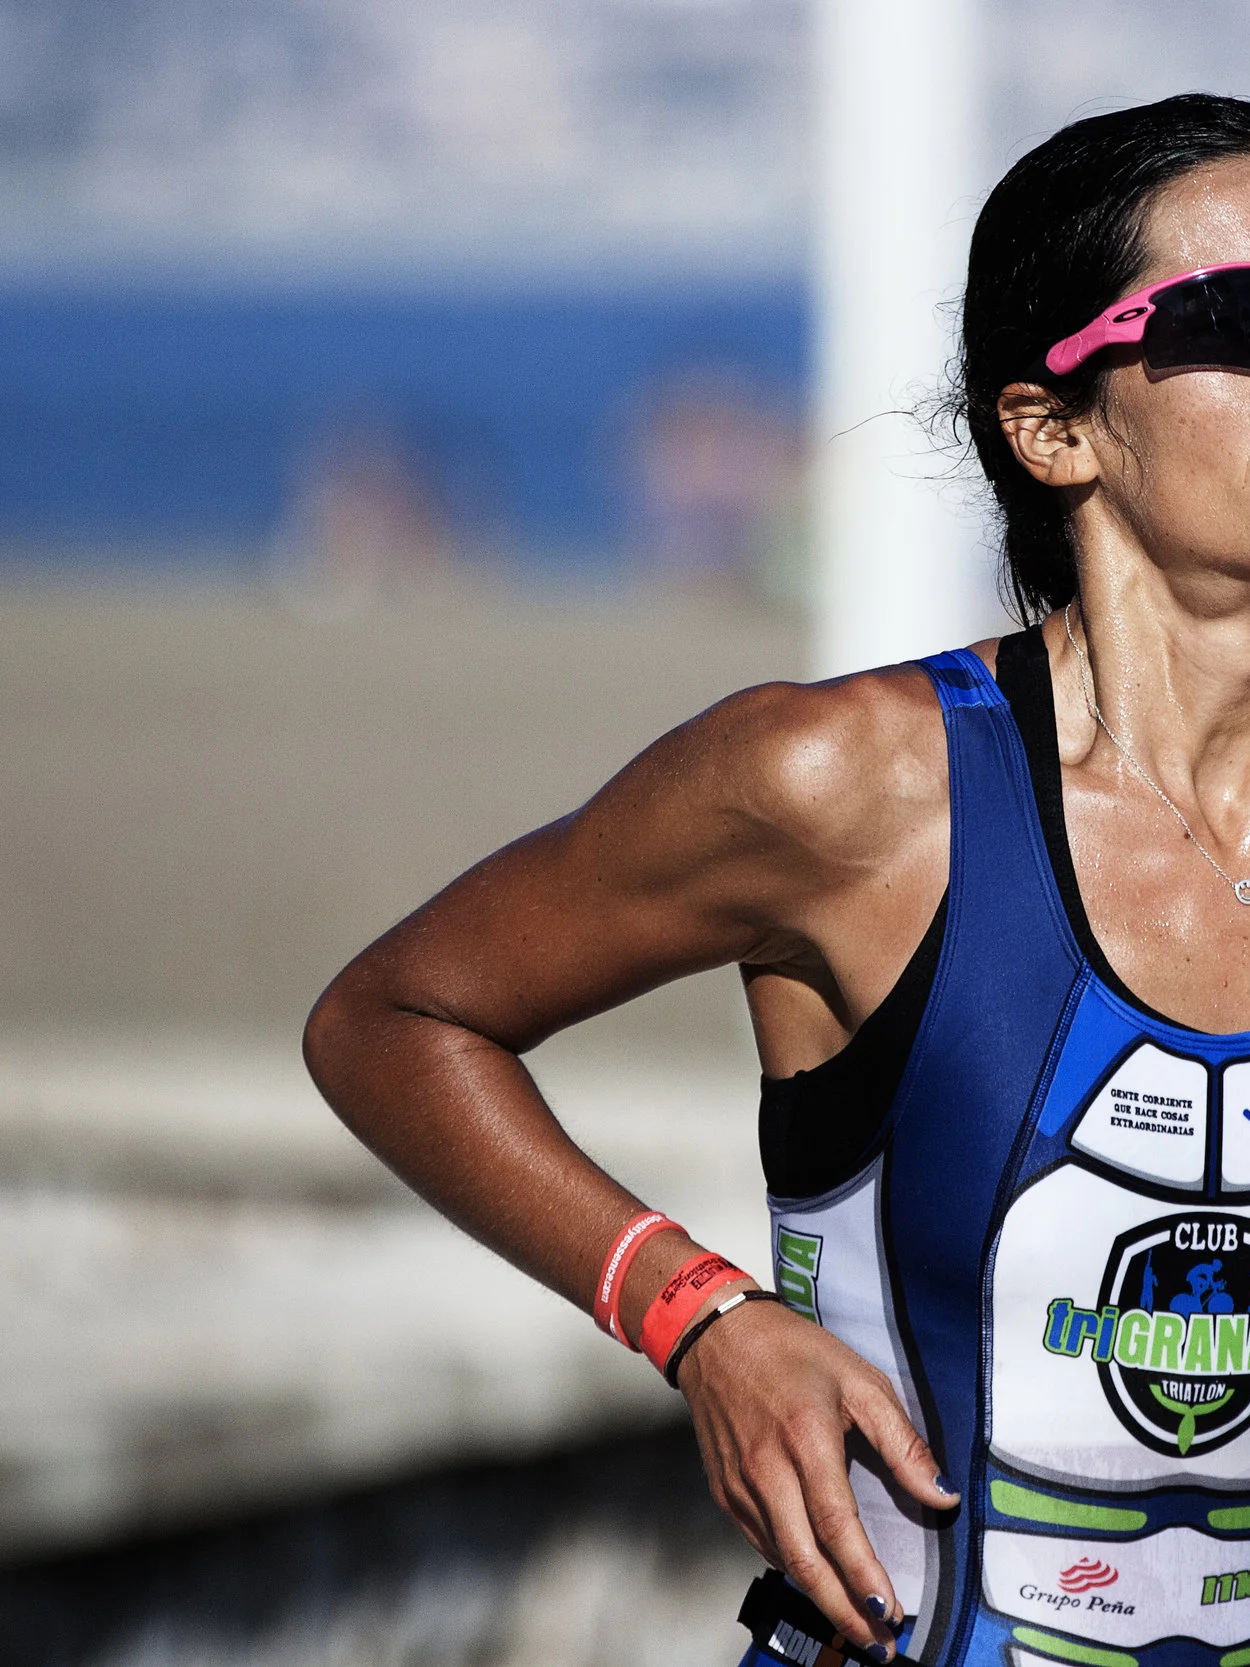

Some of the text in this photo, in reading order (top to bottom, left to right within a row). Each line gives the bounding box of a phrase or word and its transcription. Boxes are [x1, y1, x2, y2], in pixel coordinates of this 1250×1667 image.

[1110, 1088, 1193, 1109] GENTE CORRIENTE
[1113, 1103, 1190, 1123] QUE HACE COSAS
[1110, 1116, 1195, 1137] EXTRAORDINARIAS
[1174, 1222, 1239, 1251] CLUB
[1019, 1583, 1136, 1616] Grupo Peña
